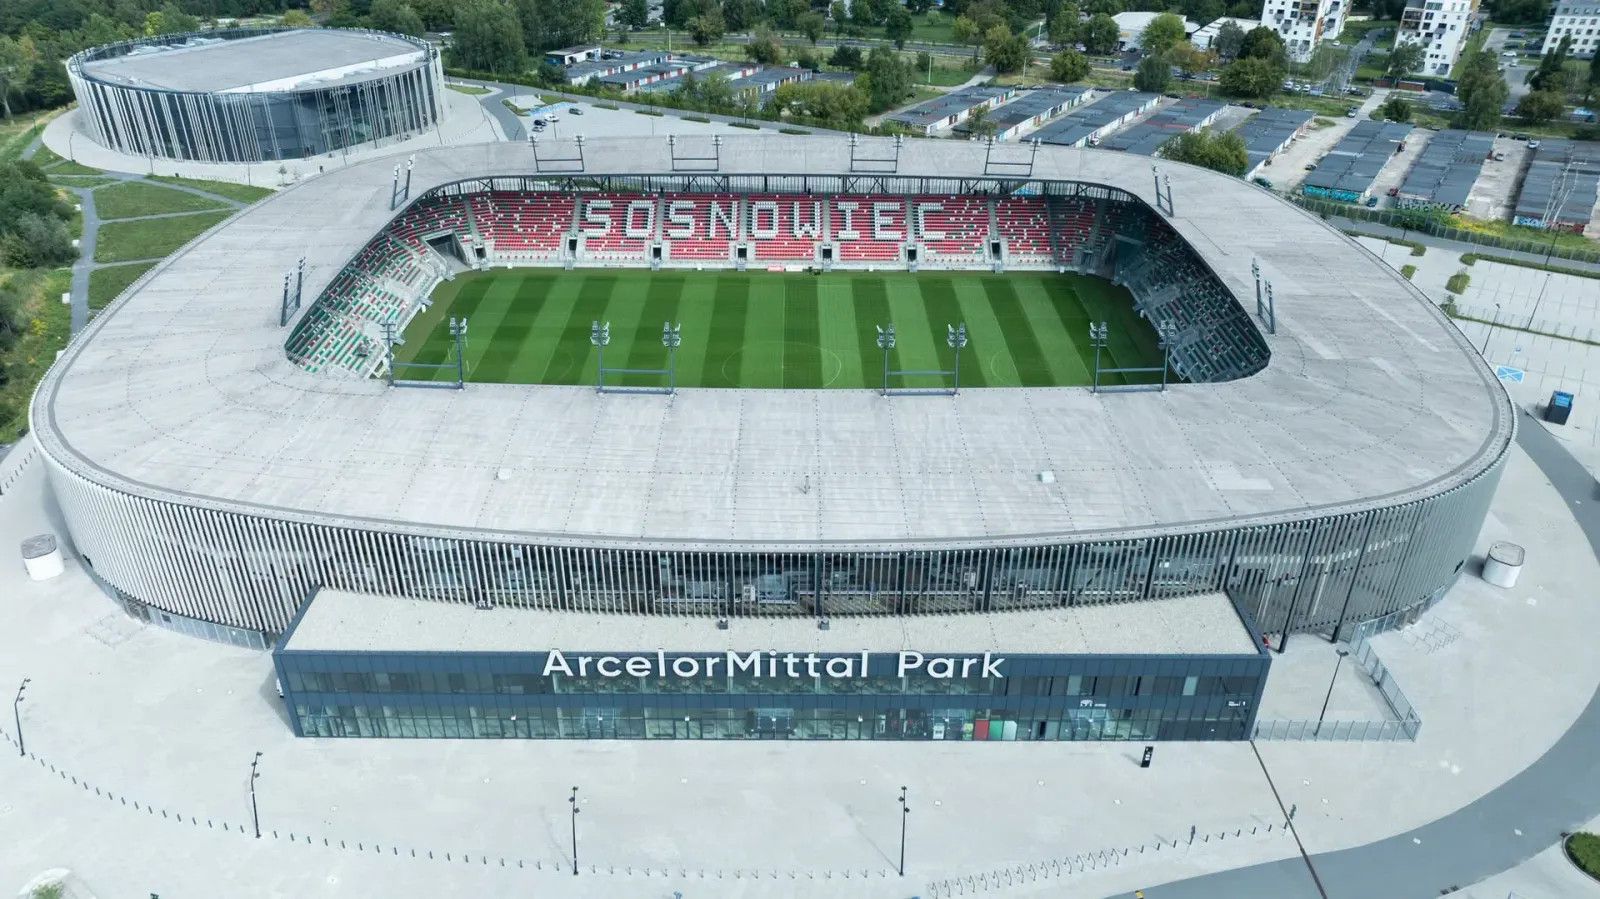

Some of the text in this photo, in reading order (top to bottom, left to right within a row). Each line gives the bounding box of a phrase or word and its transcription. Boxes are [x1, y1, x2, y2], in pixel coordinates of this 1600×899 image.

[582, 200, 947, 240] SOSNOWIEC
[542, 649, 1005, 679] ArcelorMittal Park
